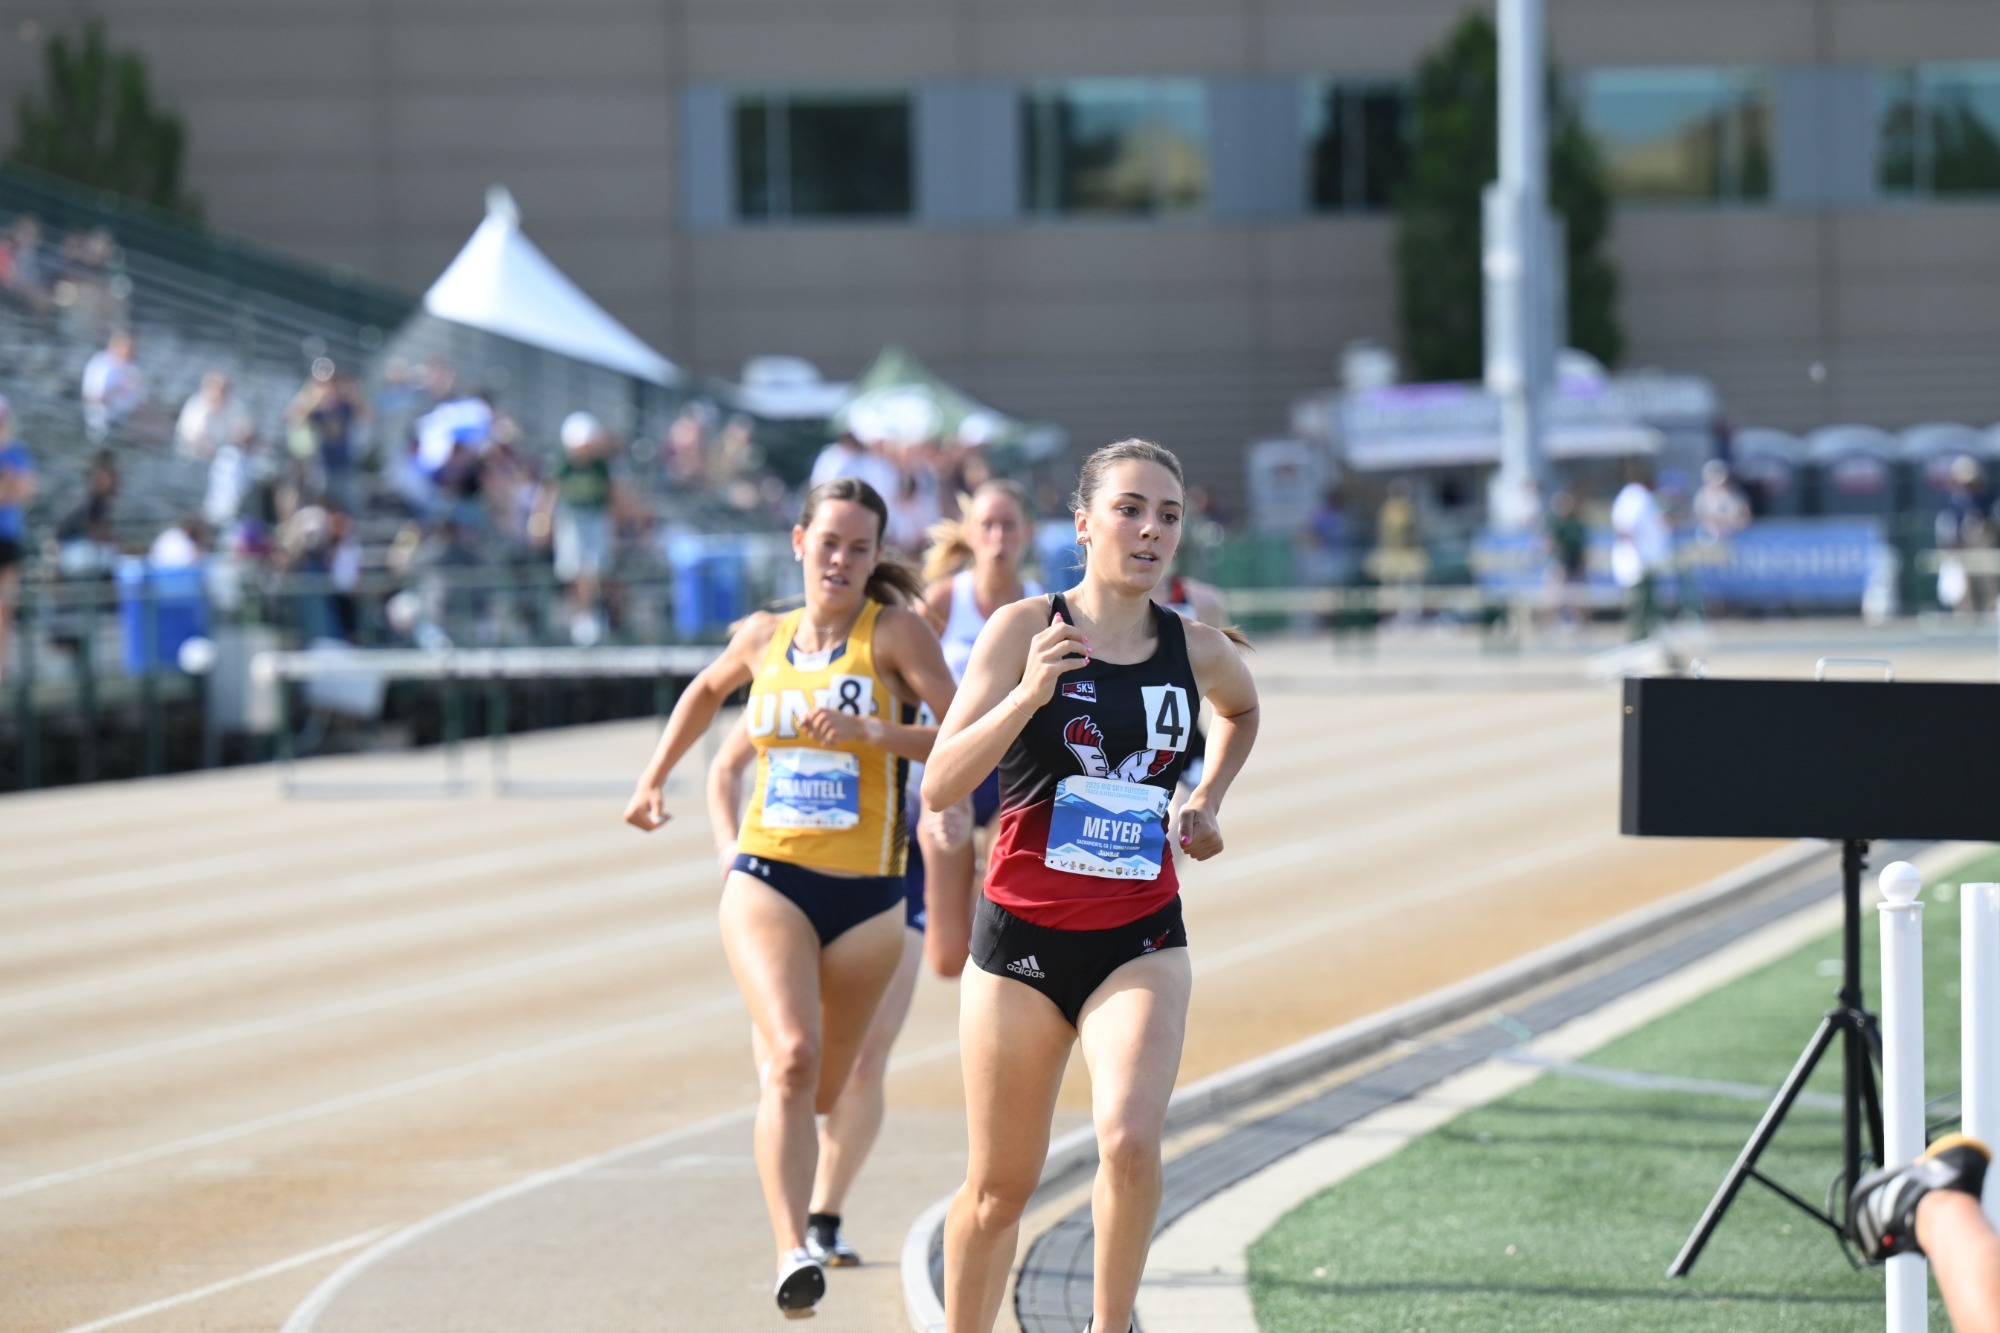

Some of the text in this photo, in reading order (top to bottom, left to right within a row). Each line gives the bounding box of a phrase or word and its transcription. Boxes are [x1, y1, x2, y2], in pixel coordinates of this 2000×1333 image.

[839, 680, 860, 715] 8
[1156, 690, 1184, 748] 4
[1086, 781, 1100, 789] 2025
[1101, 783, 1112, 791] BIG
[1112, 784, 1124, 793] SKY
[1082, 816, 1142, 844] MEYER
[1006, 964, 1045, 978] adidas
